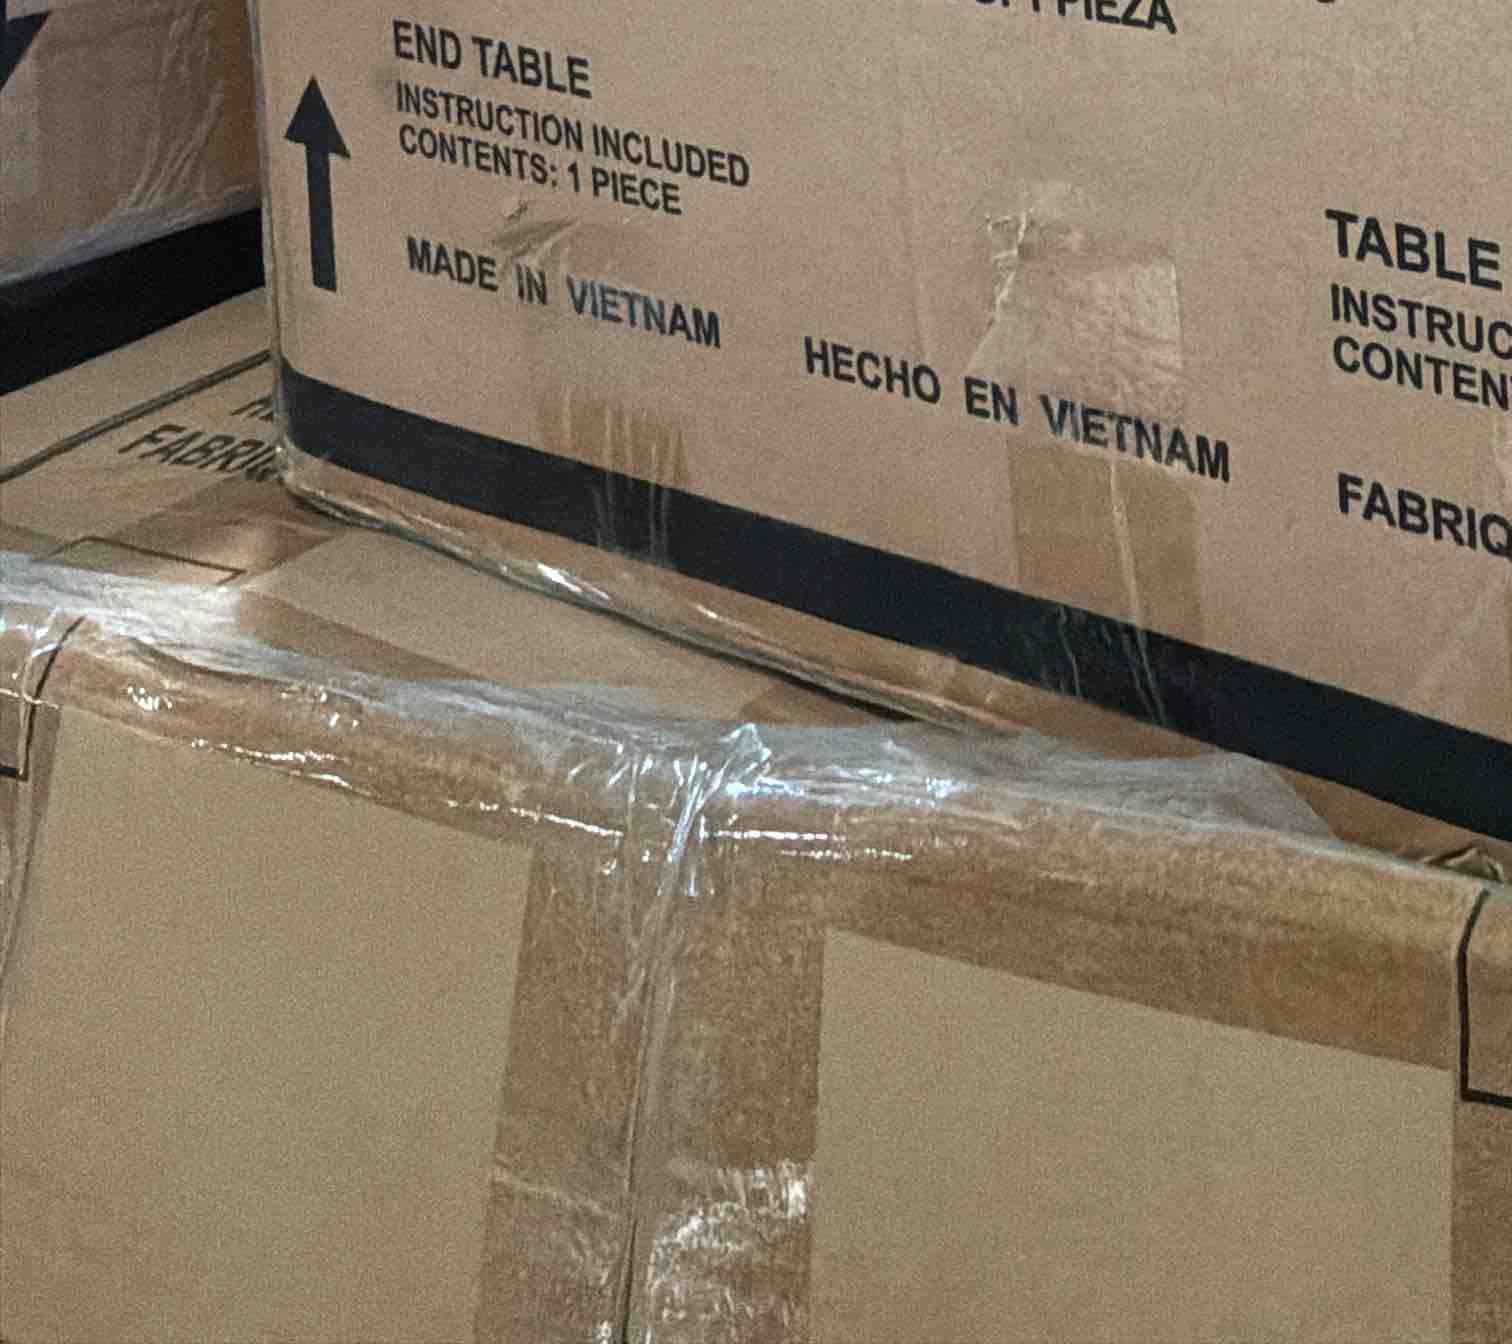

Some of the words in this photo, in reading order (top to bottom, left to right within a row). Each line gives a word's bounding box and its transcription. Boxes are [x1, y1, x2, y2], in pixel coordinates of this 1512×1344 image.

[391, 19, 463, 70] END
[471, 35, 593, 100] TABLE
[395, 80, 584, 153] INSTRUCTION
[593, 123, 751, 188] INCLUDED
[399, 123, 558, 189] CONTENTS:
[567, 161, 582, 193] 1
[590, 167, 684, 215] PIECE
[406, 235, 500, 293] MADE
[516, 262, 549, 306] IN
[566, 272, 722, 349] VIETNAM
[1324, 208, 1504, 292] TABLE
[803, 335, 942, 405] HECHO
[963, 375, 1020, 427] EN
[1038, 393, 1232, 484] VIETNAM
